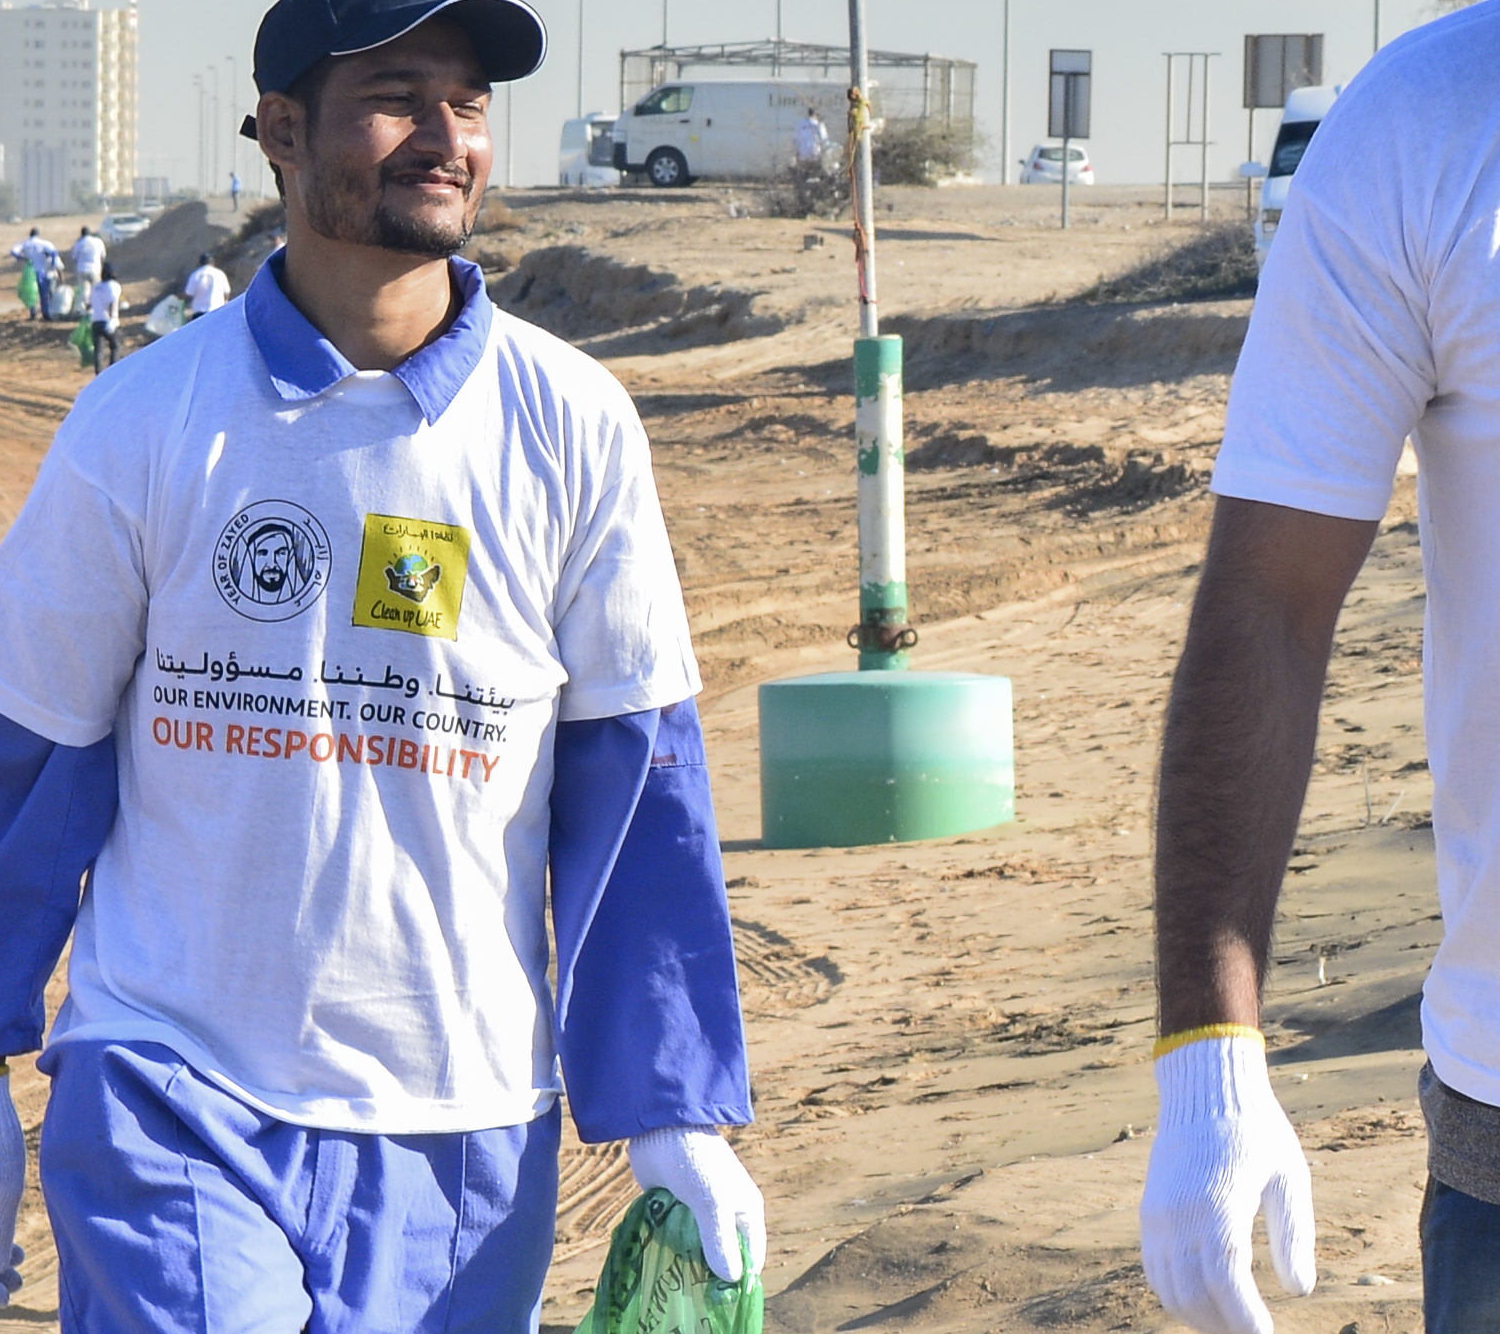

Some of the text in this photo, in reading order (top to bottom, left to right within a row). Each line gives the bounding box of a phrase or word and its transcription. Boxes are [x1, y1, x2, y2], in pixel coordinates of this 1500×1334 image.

[217, 513, 250, 605] YEAR OF ZAYED
[370, 599, 443, 629] Clean up UAE
[155, 646, 303, 683] مسؤوليتنا
[153, 685, 507, 743] OUR ENVIRONMENT. OUR COUNTRY.
[152, 716, 501, 783] OUR RESPONSIBILITY
